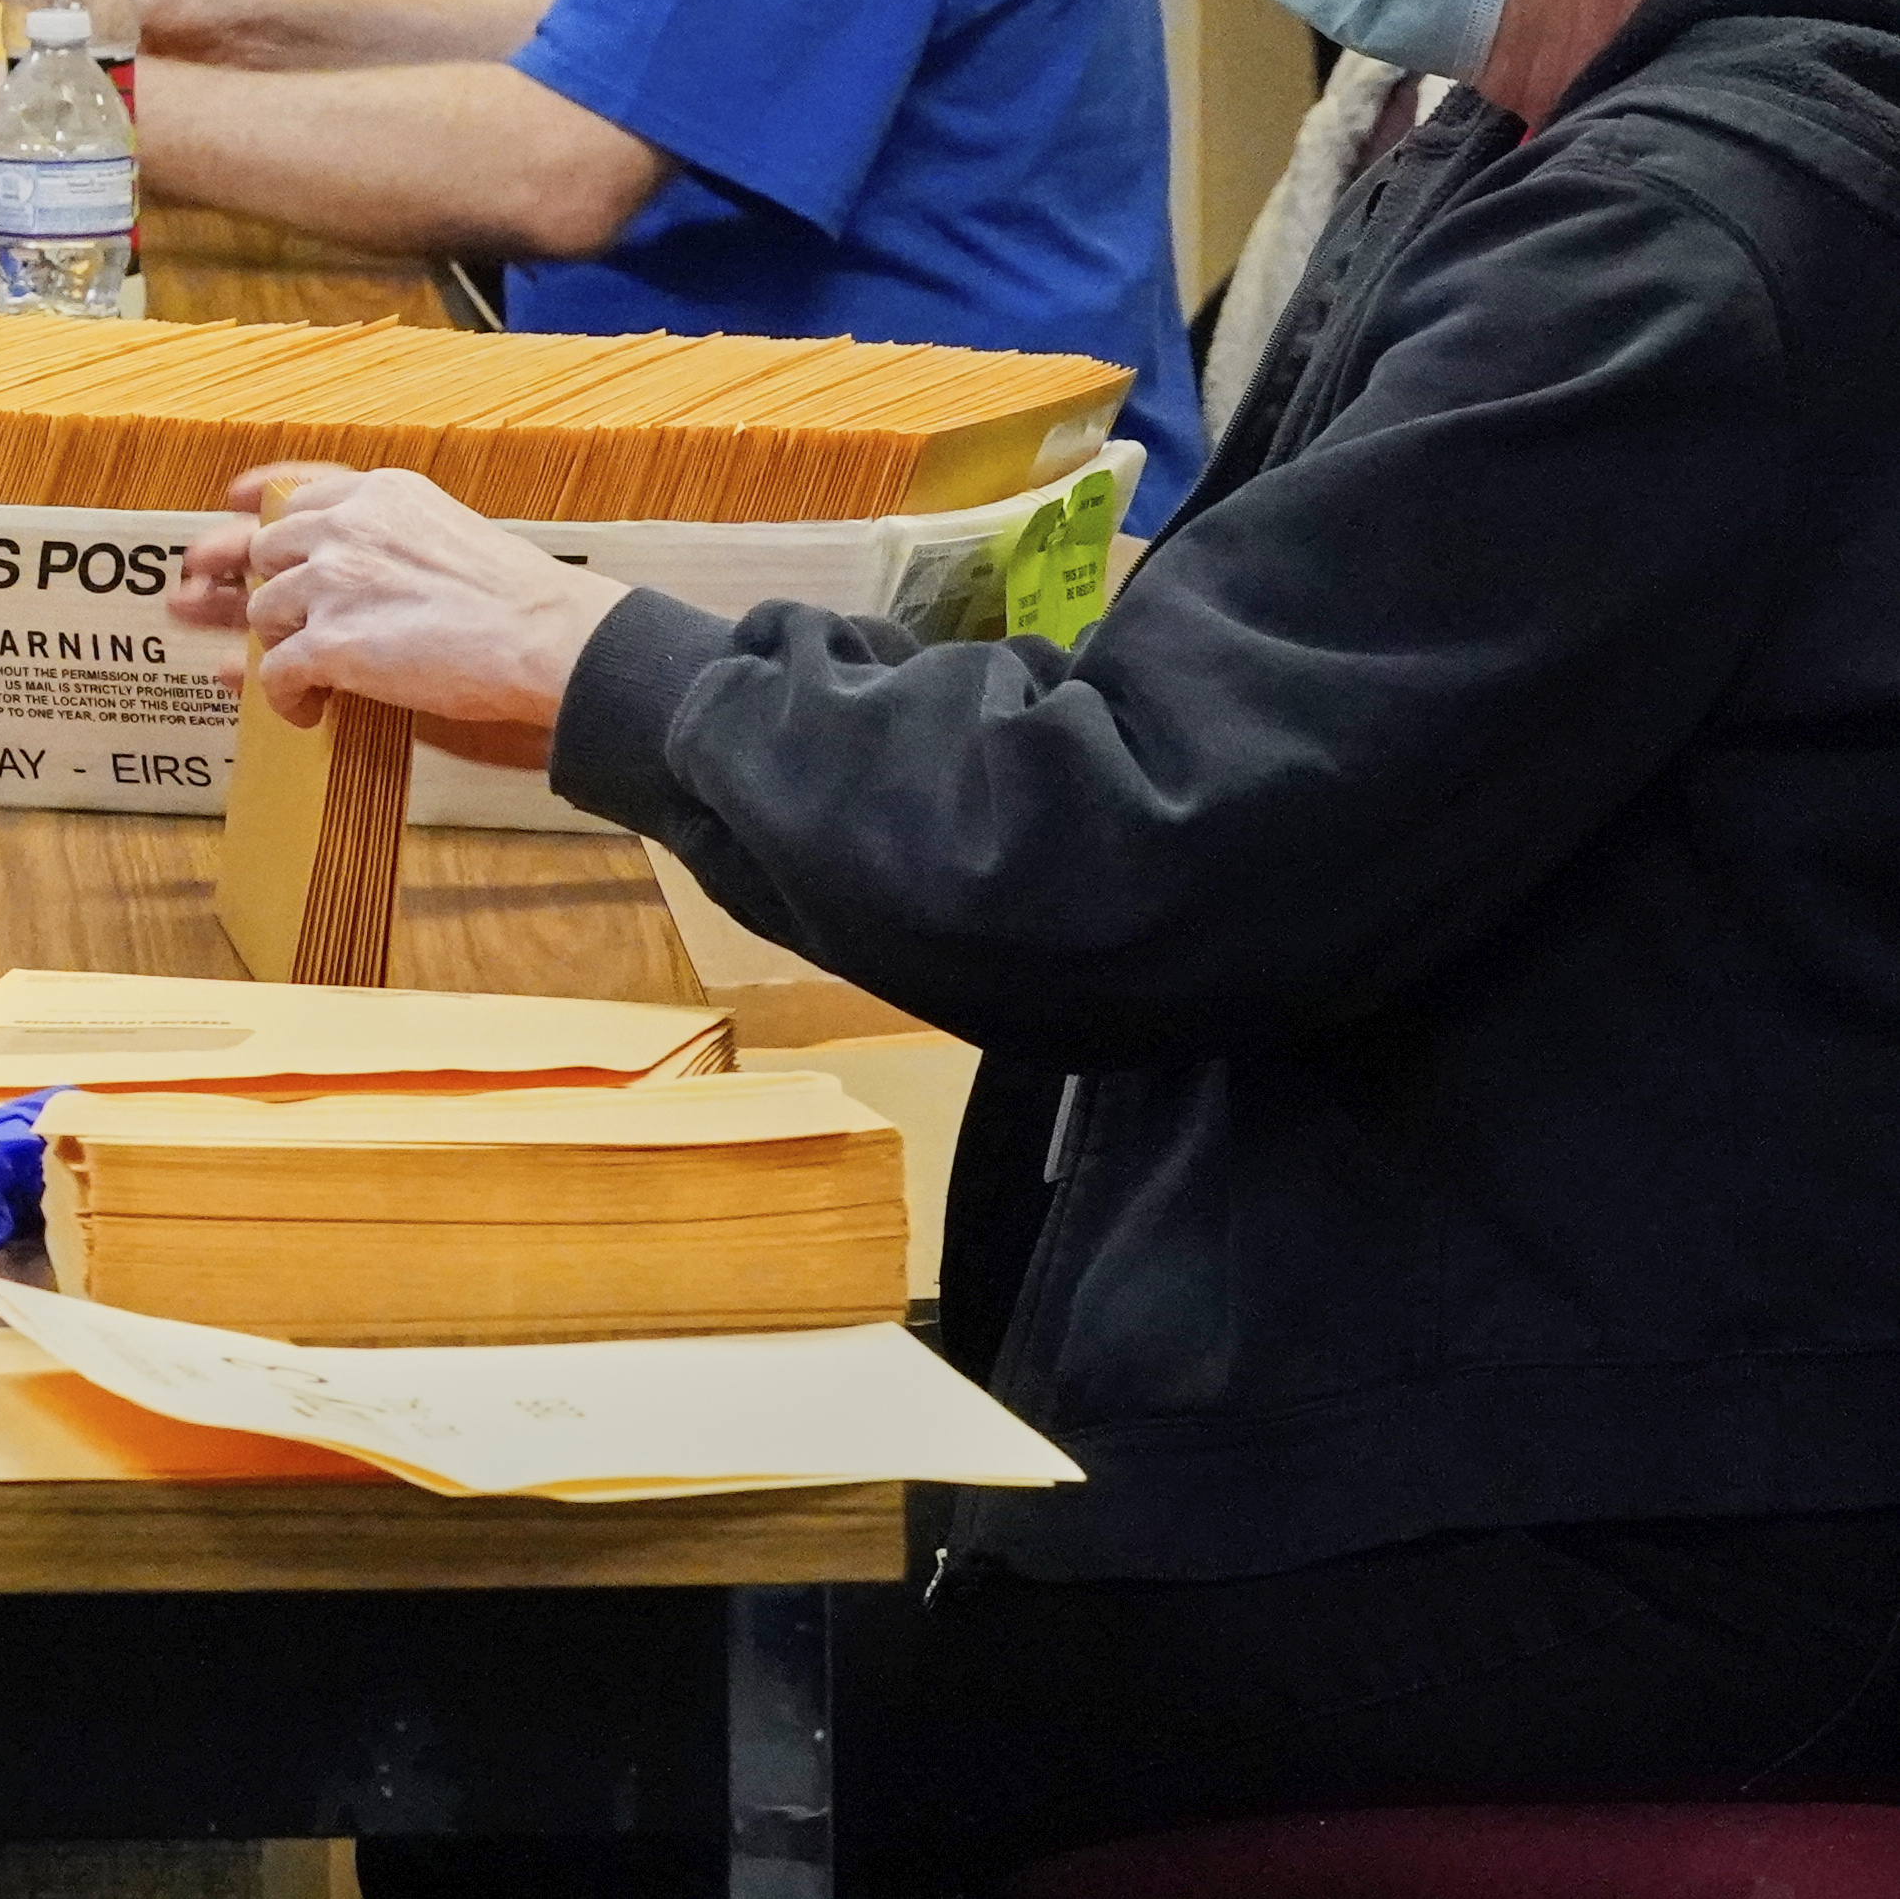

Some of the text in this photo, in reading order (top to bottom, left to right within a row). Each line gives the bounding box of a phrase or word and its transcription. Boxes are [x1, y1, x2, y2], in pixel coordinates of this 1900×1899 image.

[33, 666, 57, 678] THE
[61, 668, 138, 682] PERMISSION
[142, 672, 158, 682] OF
[163, 673, 187, 684] THE
[191, 674, 209, 685] US
[4, 679, 22, 690] US
[24, 680, 54, 692] MAIL
[58, 682, 70, 693] IS
[73, 682, 132, 695] STRICTLY
[136, 685, 213, 699] PROHIBITED
[216, 689, 231, 700] BY
[24, 693, 47, 705] THE
[52, 695, 116, 708] LOCATION
[118, 698, 136, 709] OF
[139, 699, 168, 711] THIS
[171, 700, 235, 713] EQUIPMEN
[8, 706, 24, 717] TO
[26, 707, 53, 719] ONE
[98, 711, 117, 721] OR
[120, 712, 156, 723] BOTH
[158, 714, 186, 725] FOR
[188, 715, 224, 726] EACH
[112, 753, 211, 787] EIRS
